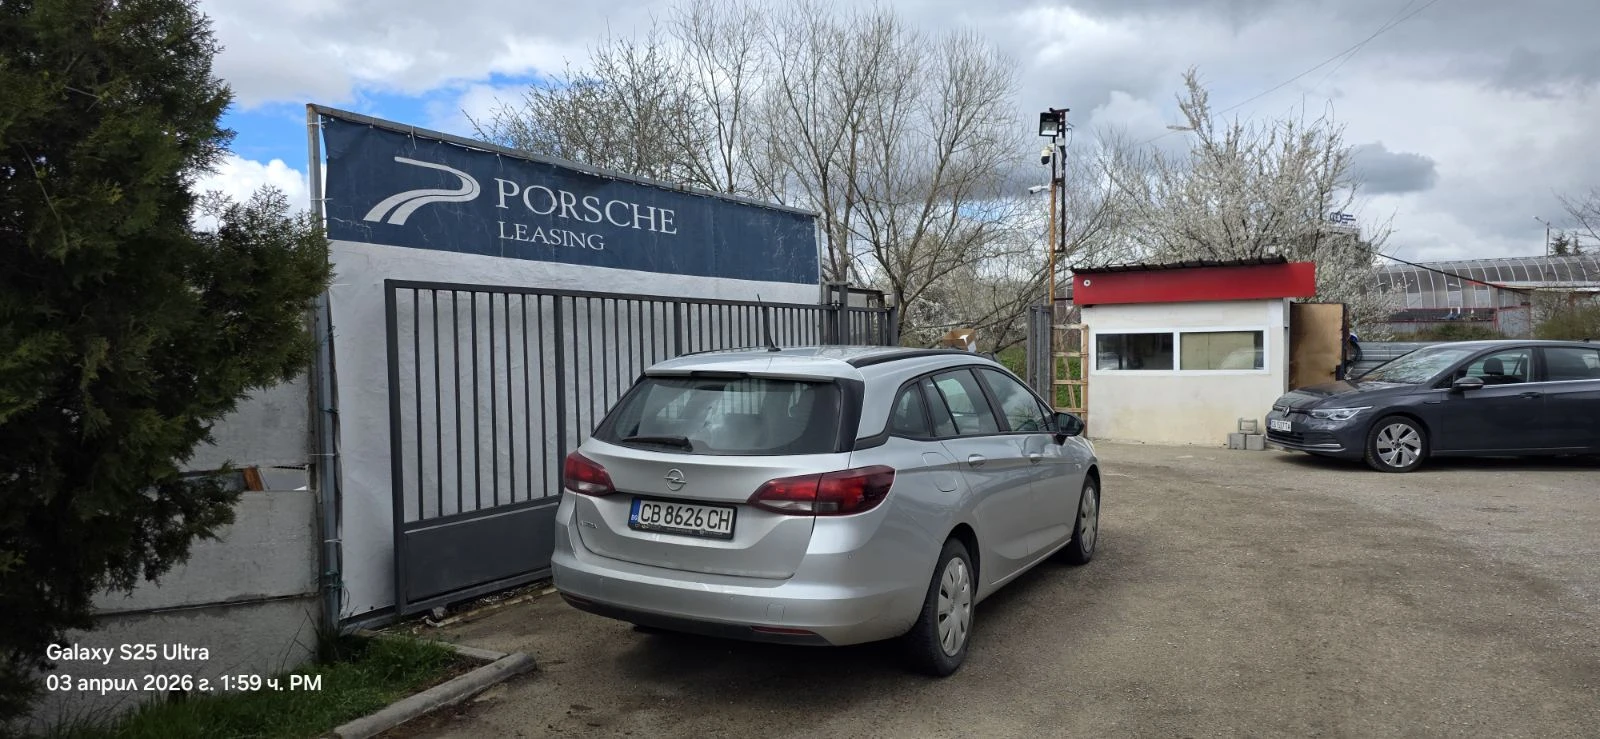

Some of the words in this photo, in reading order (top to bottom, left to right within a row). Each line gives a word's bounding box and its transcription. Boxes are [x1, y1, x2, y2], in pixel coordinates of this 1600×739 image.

[494, 177, 678, 235] PORSCHE
[498, 221, 605, 251] LEASING
[641, 503, 662, 523] CB
[664, 505, 704, 528] 8626
[707, 509, 732, 531] CH
